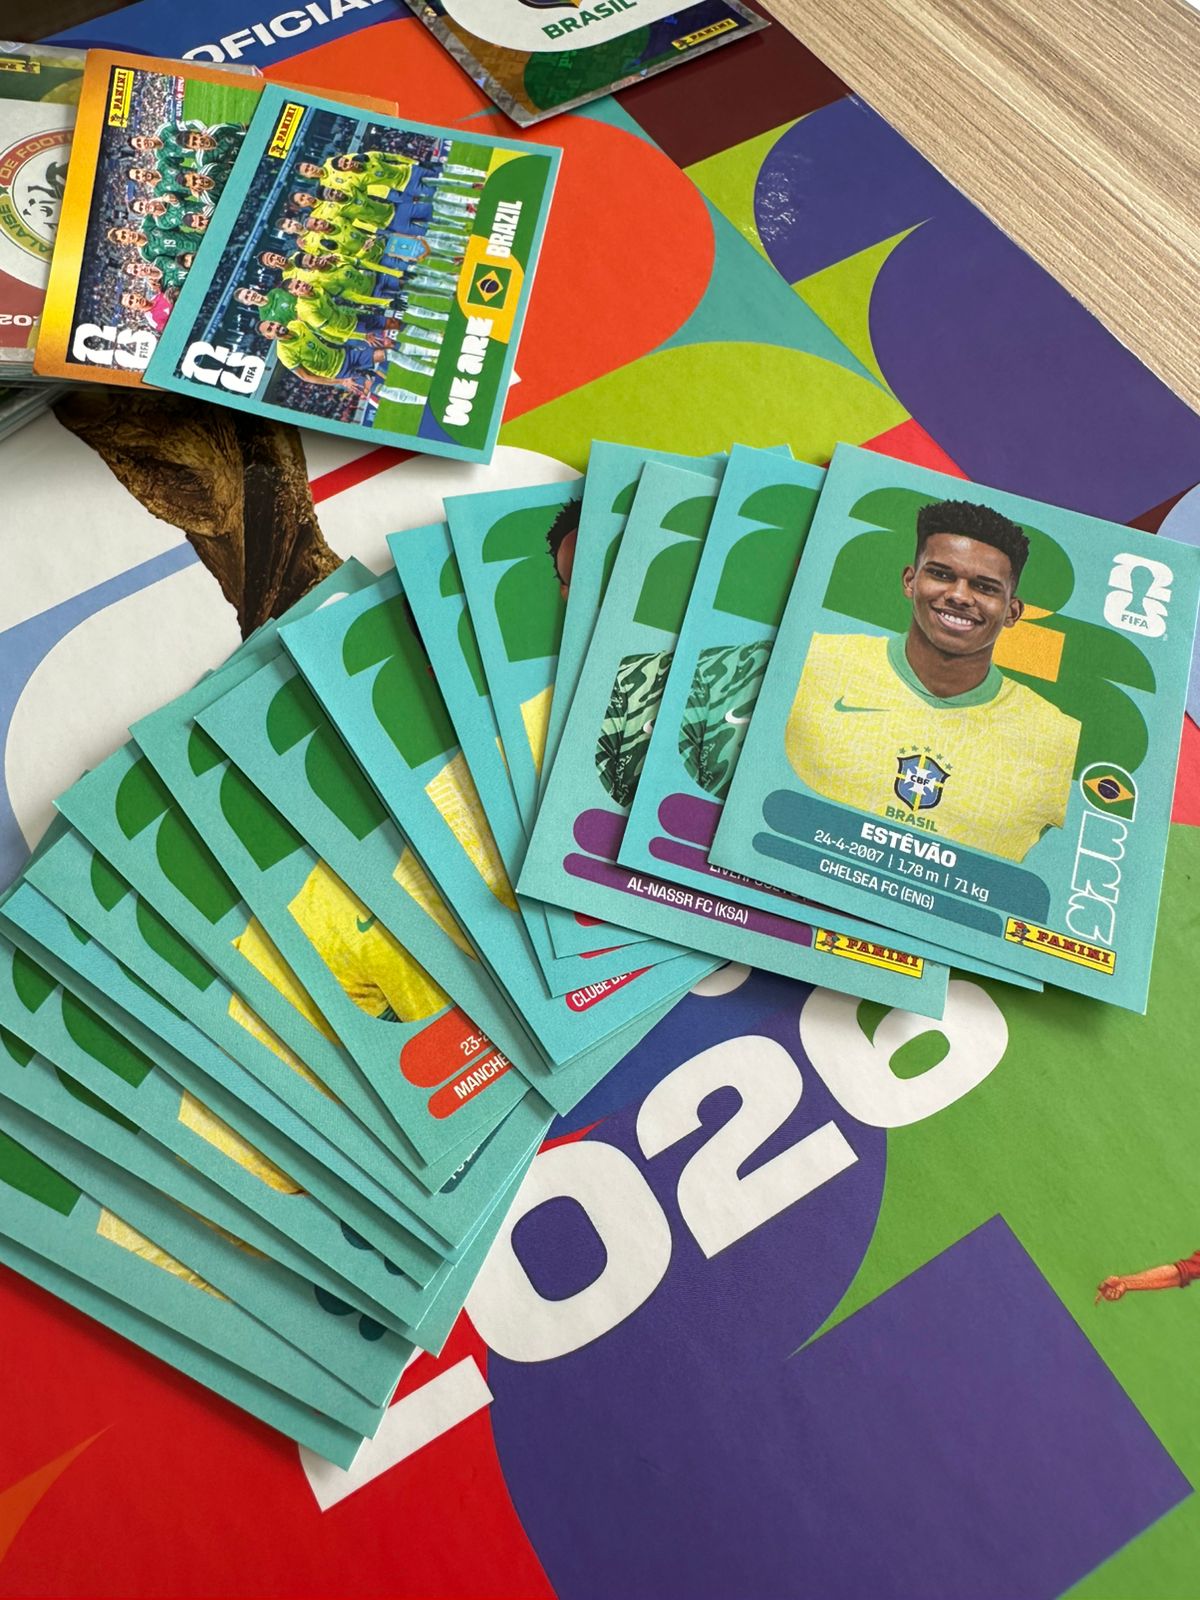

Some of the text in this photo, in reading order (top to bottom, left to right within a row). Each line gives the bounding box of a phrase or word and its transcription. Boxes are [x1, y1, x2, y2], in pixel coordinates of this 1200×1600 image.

[182, 0, 383, 63] OFICIA
[541, 0, 637, 39] BRASIL
[276, 106, 297, 143] PANINI
[16, 133, 71, 160] FOOT
[485, 200, 523, 259] BRAZIL
[138, 341, 149, 359] FIFA
[244, 366, 258, 383] FIFA
[442, 315, 494, 426] WE ARE
[1120, 614, 1149, 629] FIFA
[910, 774, 931, 786] CBF
[885, 805, 938, 832] BRASIL
[860, 822, 957, 868] ESTÊVÃO
[814, 829, 885, 863] 24-4-2007
[925, 869, 940, 884] m
[954, 877, 969, 894] 71
[971, 883, 990, 903] kg
[819, 858, 878, 890] CHELSEA
[880, 878, 899, 897] FC
[900, 886, 935, 911] (ENG)
[626, 876, 694, 908] AL-NASSR
[695, 896, 713, 913] FC
[714, 901, 749, 925] (KSA)
[847, 937, 919, 967] PANINI
[1036, 930, 1112, 964] PANINI
